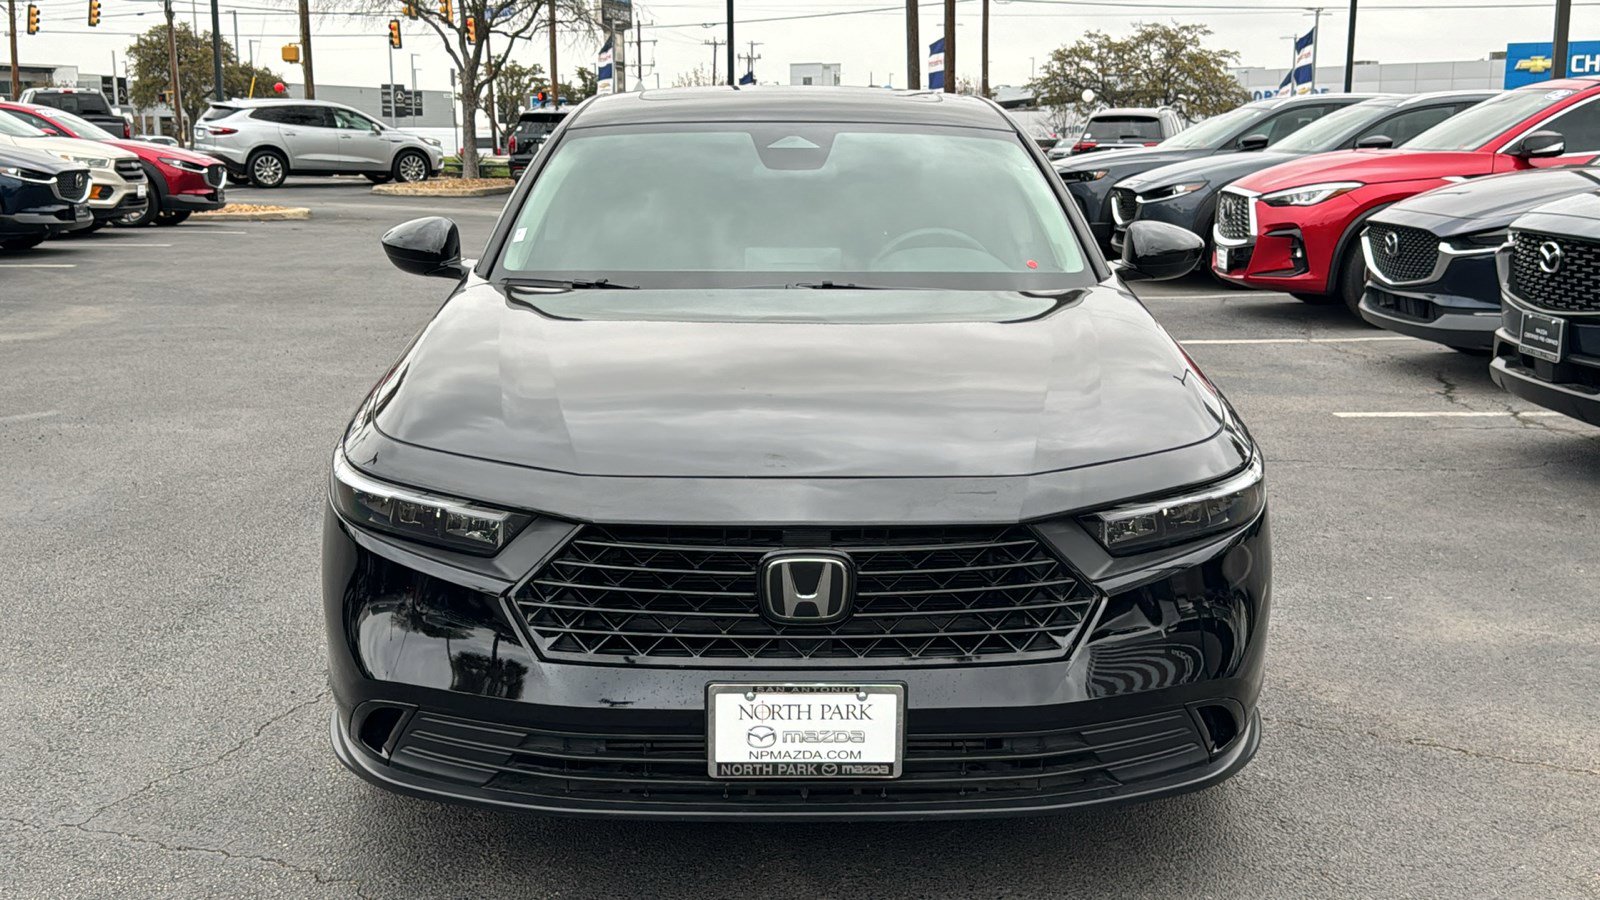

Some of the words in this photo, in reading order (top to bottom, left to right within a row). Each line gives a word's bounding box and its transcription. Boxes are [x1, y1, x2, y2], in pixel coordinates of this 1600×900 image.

[738, 702, 812, 721] NORTH
[820, 703, 873, 721] PARK
[782, 730, 866, 744] mazda
[748, 750, 862, 760] NPMAZDA.COM
[720, 763, 773, 776] NORTH
[777, 763, 818, 776] PARK
[841, 764, 890, 775] mazda
